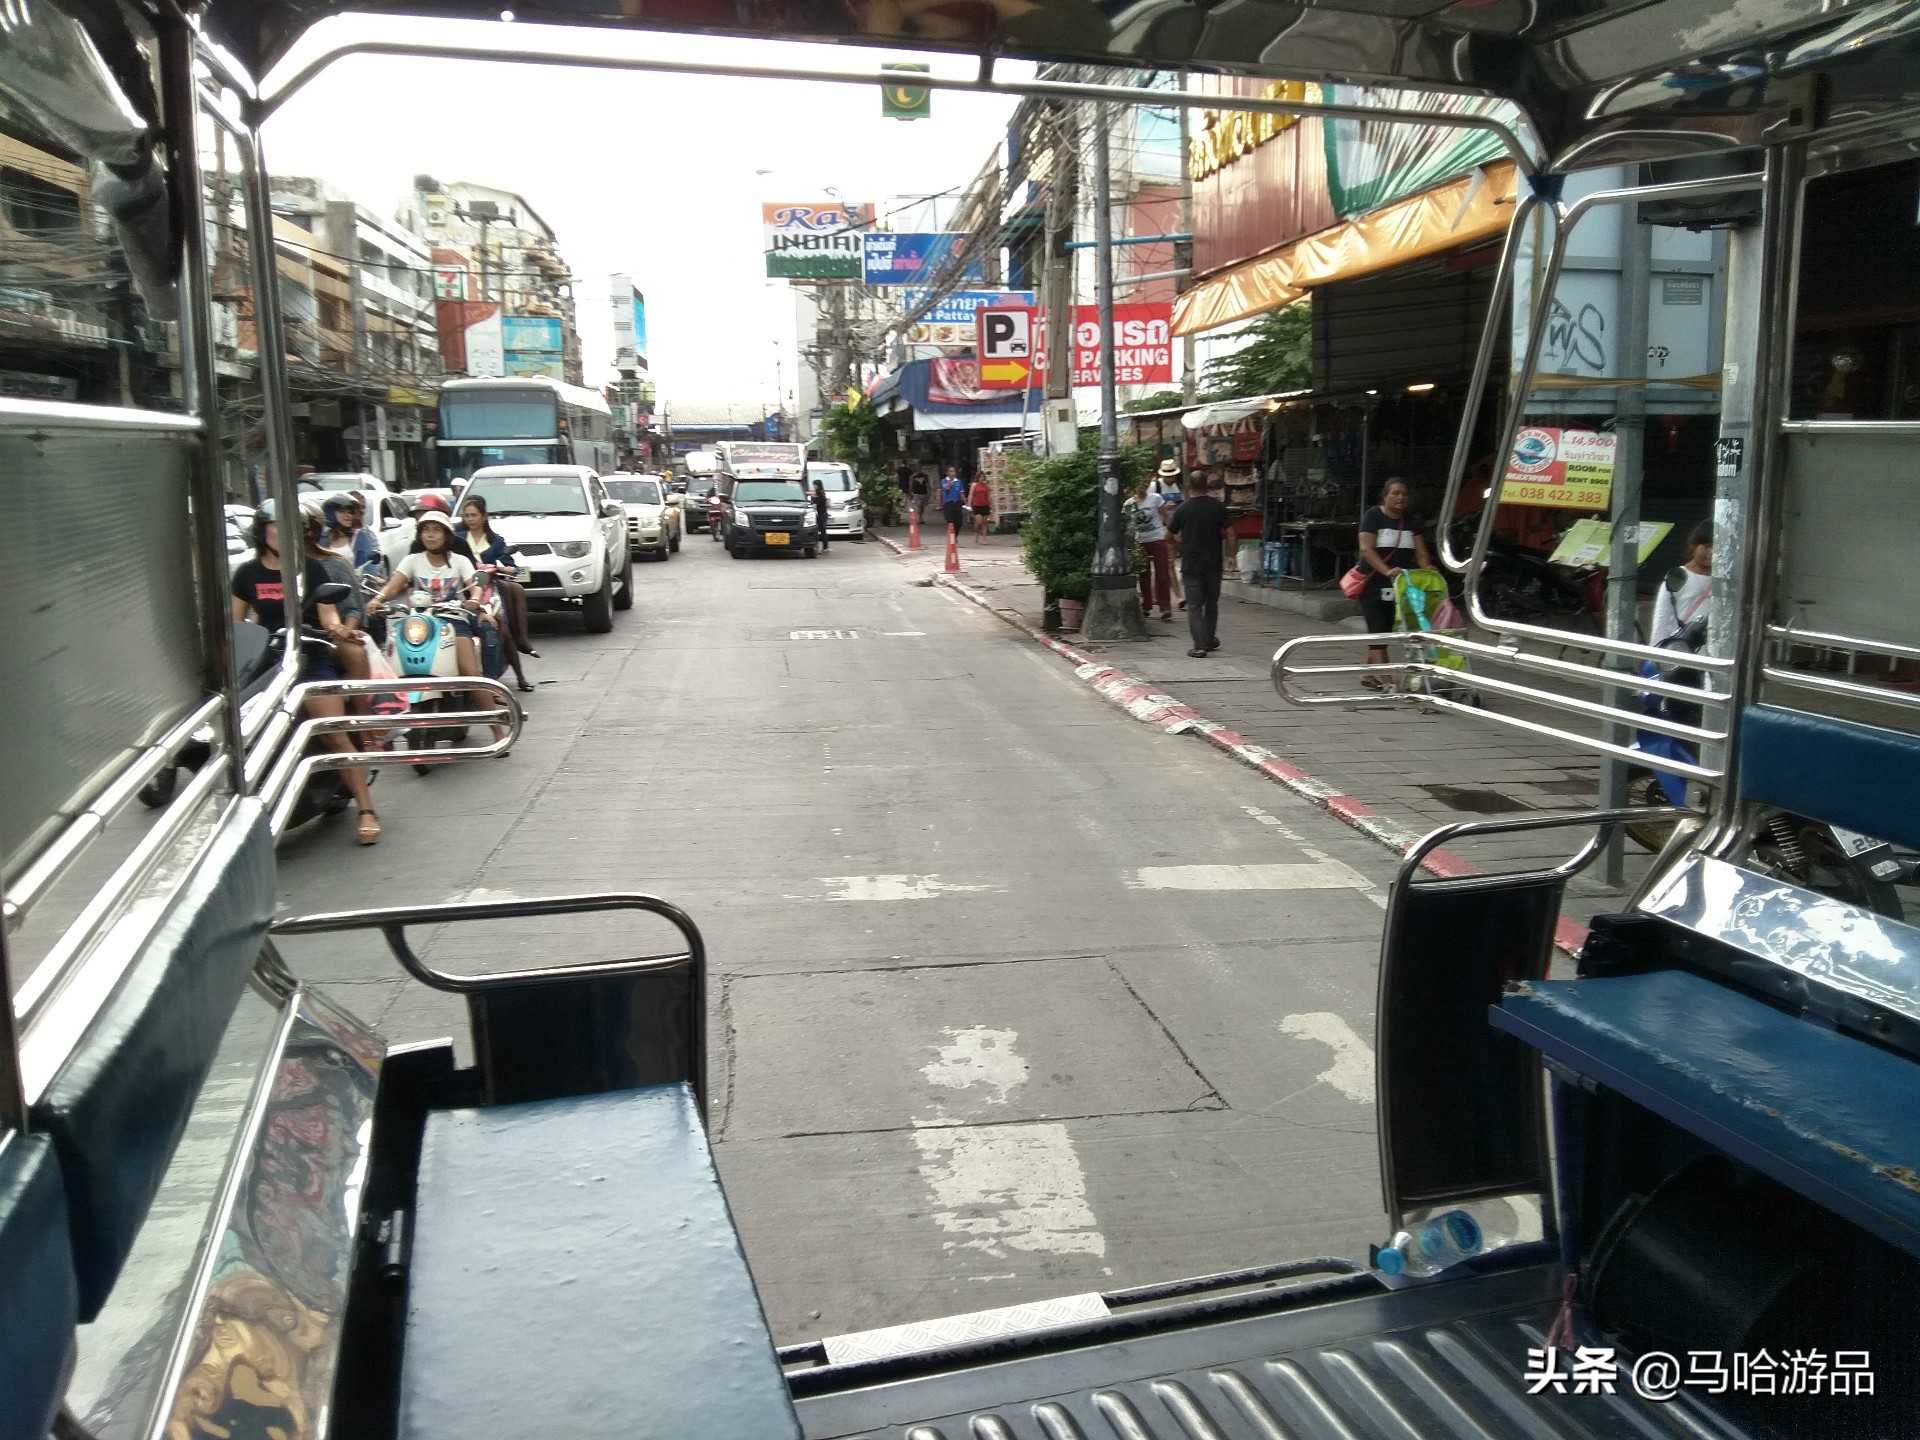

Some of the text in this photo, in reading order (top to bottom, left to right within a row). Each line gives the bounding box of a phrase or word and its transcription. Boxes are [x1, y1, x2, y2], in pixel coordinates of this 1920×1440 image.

[936, 310, 976, 323] Pattay
[985, 314, 1015, 354] P
[1072, 367, 1144, 383] ERVCES
[1568, 464, 1597, 473] ROOM
[1566, 476, 1589, 485] RENT
[1520, 487, 1546, 500] 038
[1548, 490, 1574, 502] 422
[1577, 492, 1602, 504] 383
